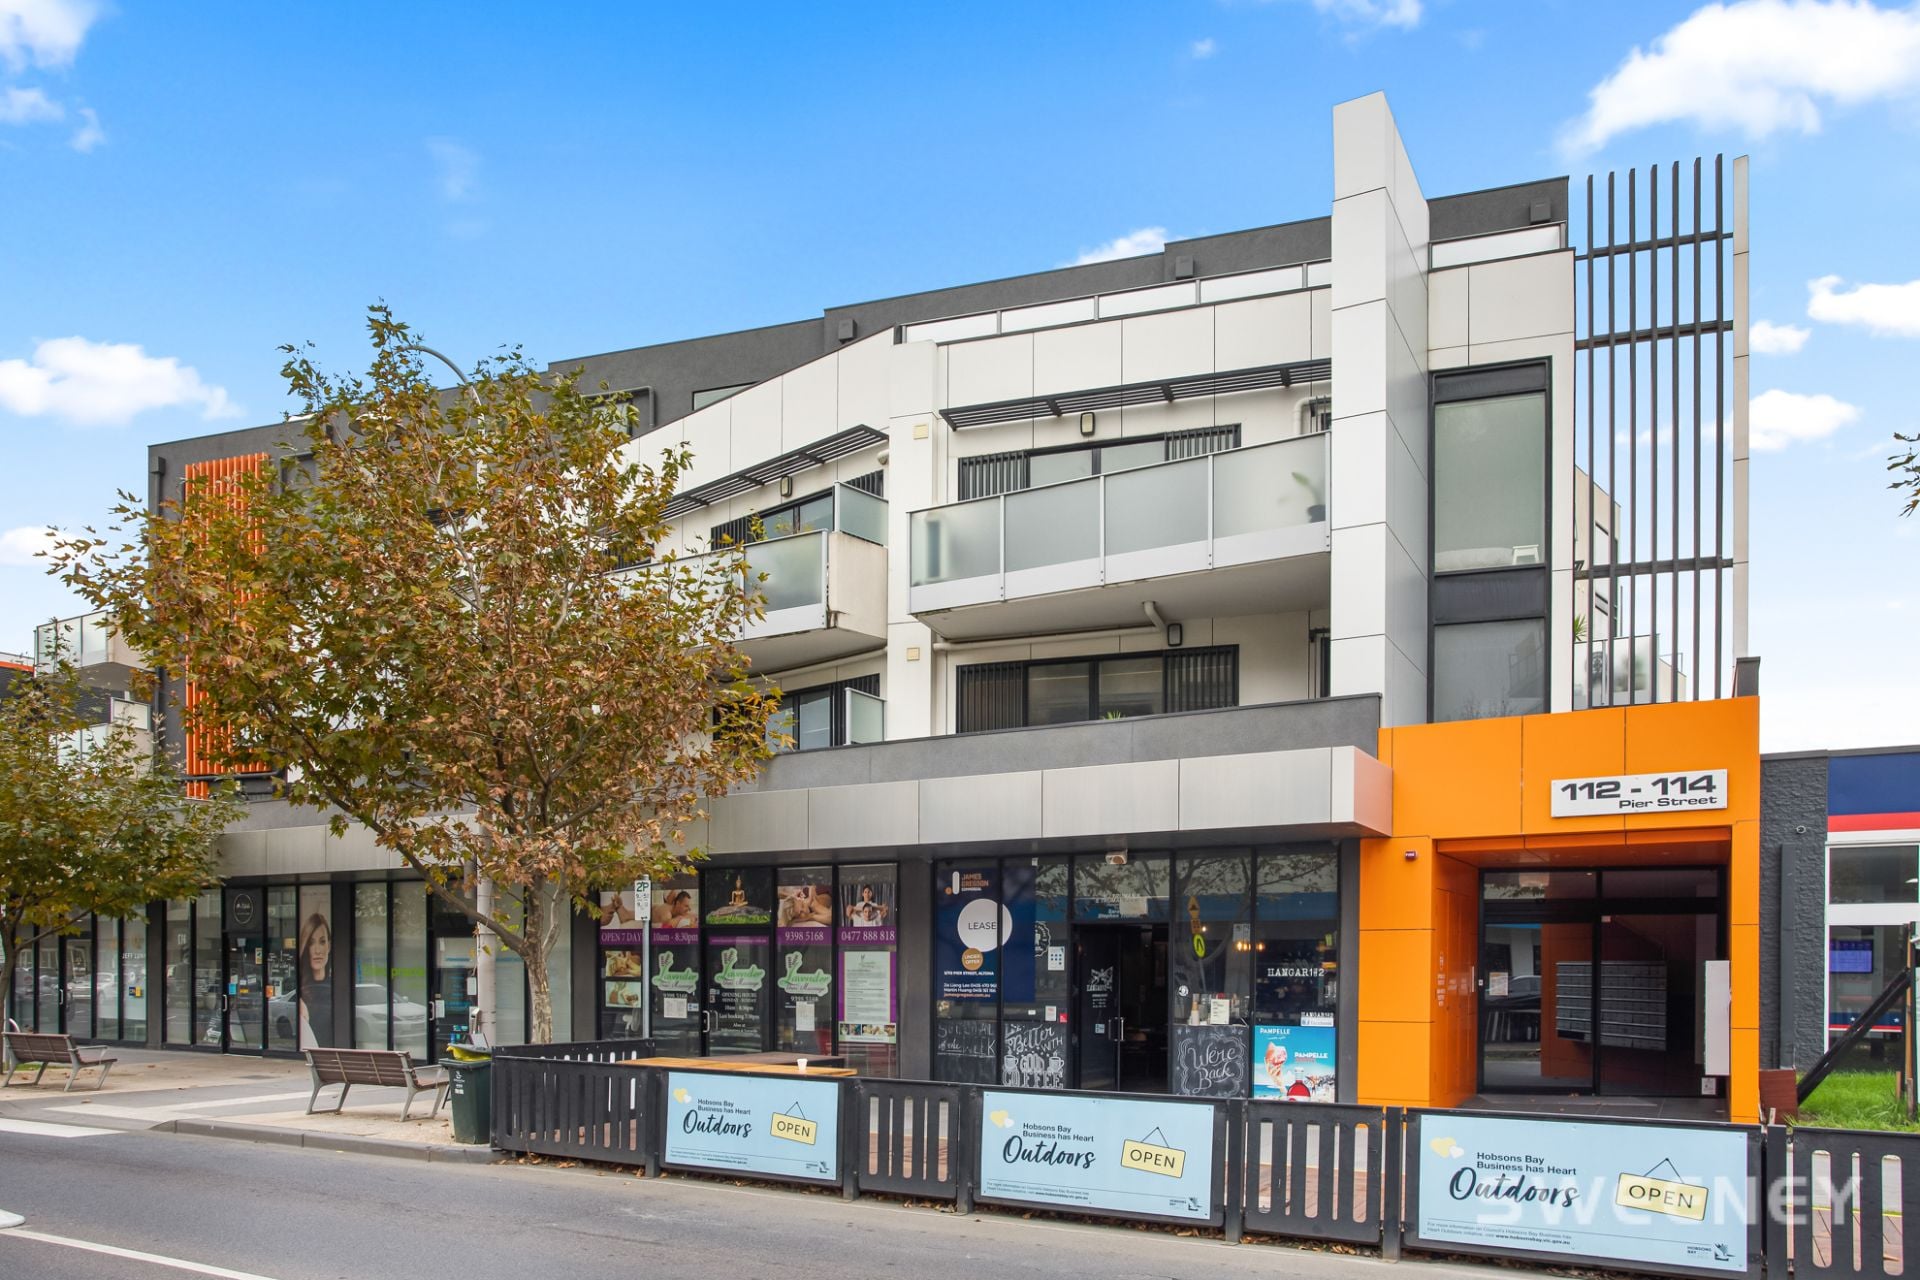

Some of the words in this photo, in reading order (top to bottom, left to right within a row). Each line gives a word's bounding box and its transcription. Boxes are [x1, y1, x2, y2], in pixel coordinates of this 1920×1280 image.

[1561, 780, 1621, 801] 112
[1651, 774, 1717, 795] 114
[1619, 799, 1653, 809] Pier
[1657, 796, 1718, 807] Street
[636, 881, 650, 892] 2P
[968, 921, 998, 930] LEASE
[601, 932, 619, 941] OPEN
[626, 932, 642, 941] DAY
[785, 931, 804, 941] 9398
[805, 931, 824, 941] 5168
[841, 931, 861, 941] 0477
[863, 931, 878, 941] 888
[879, 931, 895, 941] 818
[1259, 1027, 1291, 1035] PAMPELLE
[1293, 1051, 1329, 1059] PAMPELLE
[1192, 1061, 1236, 1094] Back
[697, 1098, 722, 1107] Hobsons
[723, 1100, 734, 1108] Bay
[697, 1105, 723, 1113] Business
[734, 1108, 751, 1116] Heart
[682, 1109, 753, 1139] Outdoors
[776, 1120, 811, 1138] OPEN
[1022, 1122, 1056, 1132] Hobsons
[1057, 1124, 1072, 1134] Bay
[1022, 1130, 1056, 1140] Business
[1057, 1132, 1071, 1141] has
[1072, 1133, 1094, 1143] Heart
[1002, 1135, 1096, 1170] Outdoors
[1129, 1148, 1176, 1169] OPEN
[1476, 1152, 1523, 1164] Hobsons
[1524, 1154, 1545, 1166] Bay
[1476, 1161, 1524, 1173] Business
[1525, 1163, 1546, 1174] has
[1547, 1165, 1577, 1176] Heart
[1449, 1166, 1580, 1208] Outdoors
[1628, 1185, 1694, 1209] OPEN
